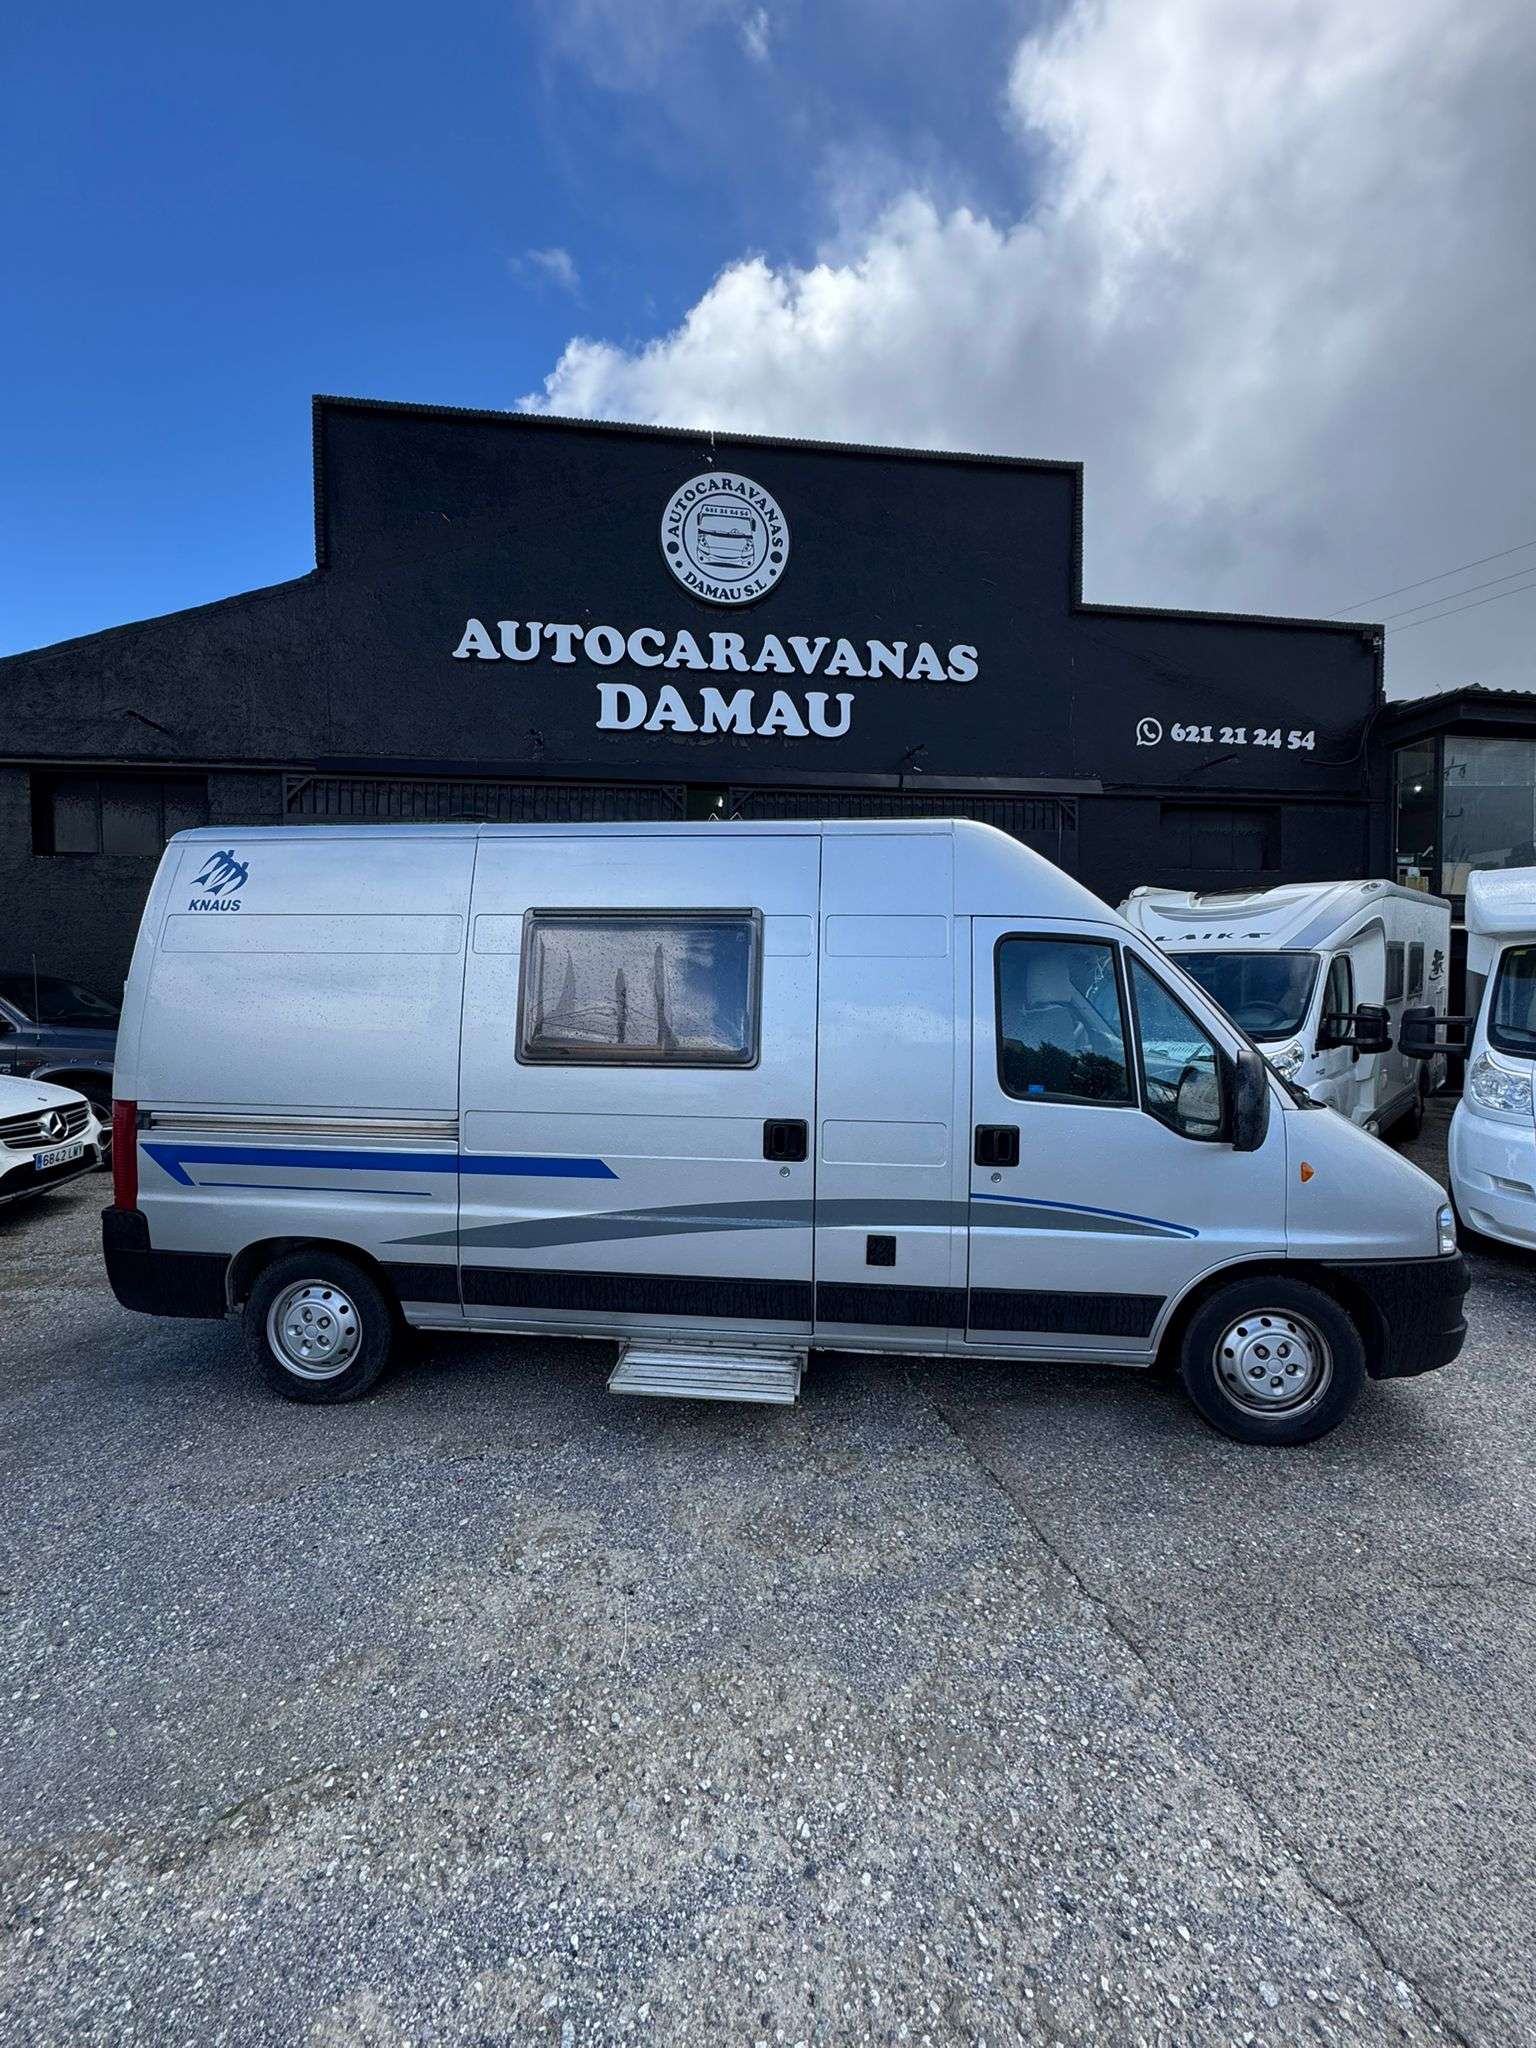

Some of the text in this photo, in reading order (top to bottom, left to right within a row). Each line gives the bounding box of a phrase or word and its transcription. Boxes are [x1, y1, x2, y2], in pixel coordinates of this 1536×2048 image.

[667, 478, 784, 548] AUTOCARAVANAS
[683, 571, 742, 600] DAMAU
[452, 618, 979, 682] AUTOCARAVANAS
[596, 683, 855, 738] DAMAU
[1170, 722, 1316, 751] 621 21 24 54
[188, 899, 242, 912] KNAUS
[1154, 932, 1272, 942] LAIKA
[43, 1149, 67, 1167] 6842
